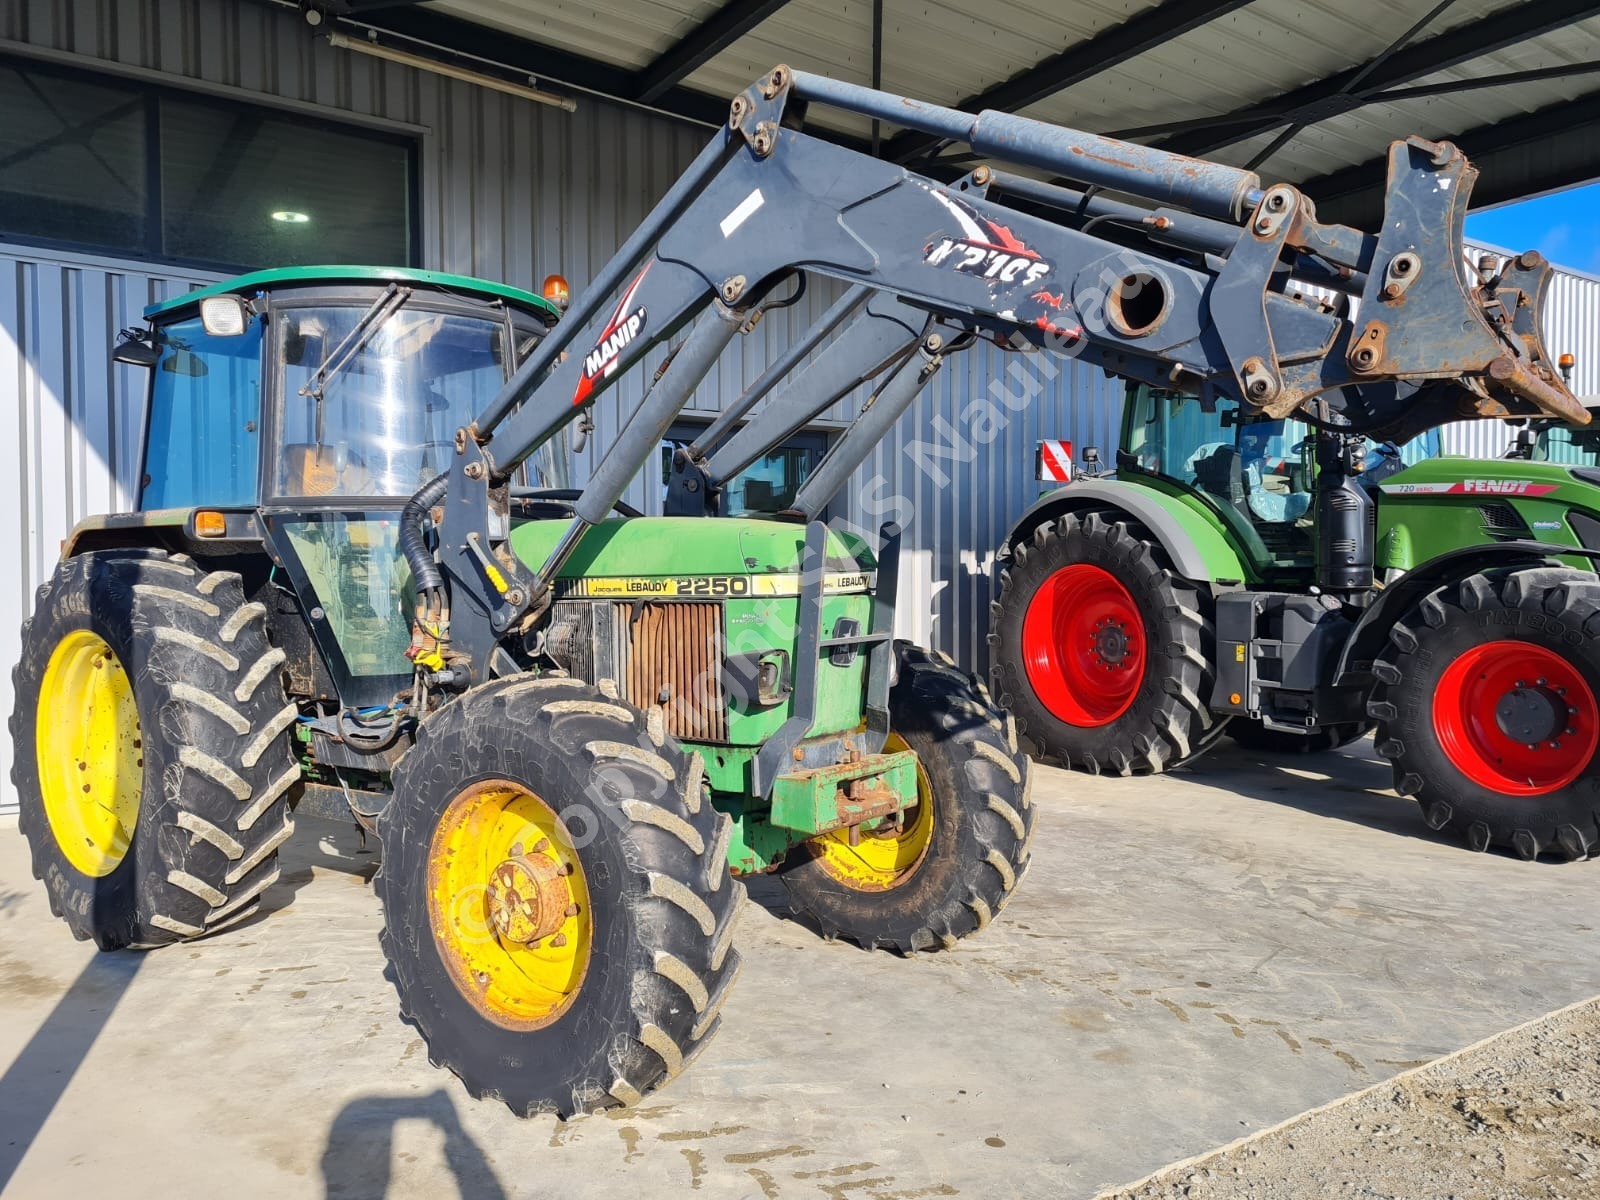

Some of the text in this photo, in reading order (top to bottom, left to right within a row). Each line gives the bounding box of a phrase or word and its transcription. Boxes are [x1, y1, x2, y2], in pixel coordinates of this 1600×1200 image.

[1463, 479, 1534, 493] FENDT
[593, 577, 748, 595] Jacques LEBAUDY 2250
[837, 575, 868, 588] LEBAUDY
